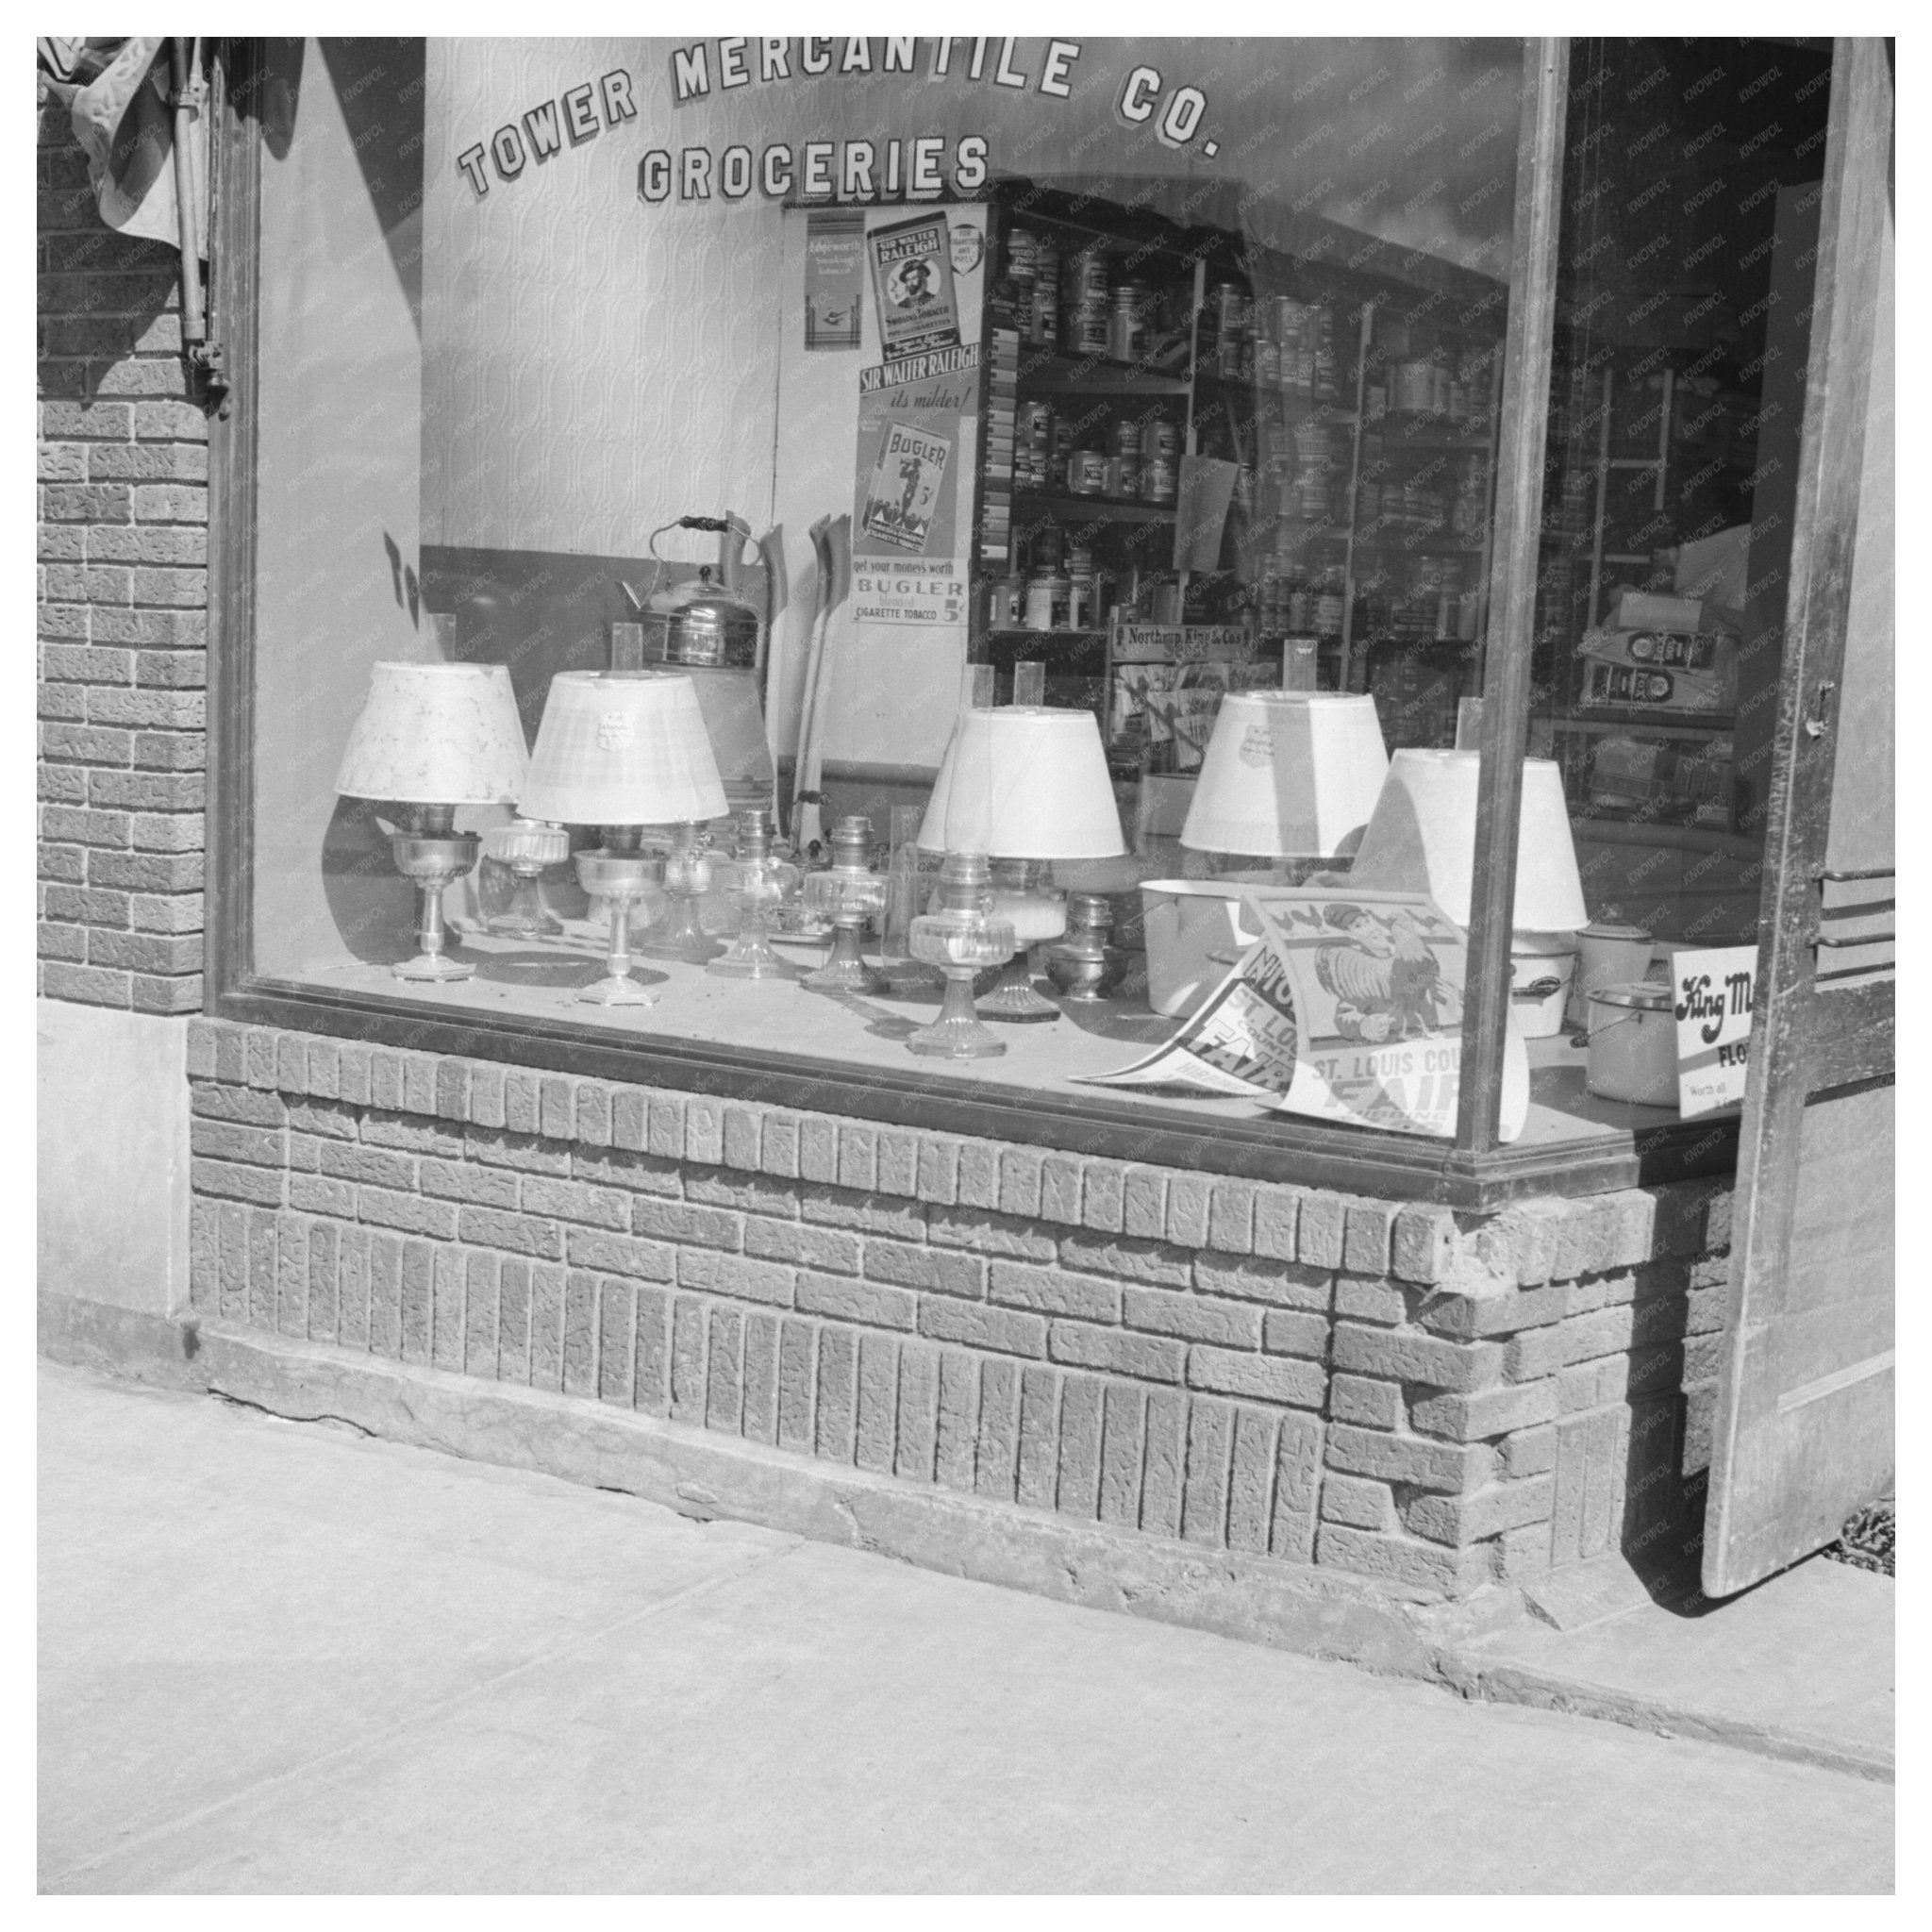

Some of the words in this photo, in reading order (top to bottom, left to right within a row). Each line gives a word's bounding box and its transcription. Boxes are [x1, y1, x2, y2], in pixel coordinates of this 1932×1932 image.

[457, 68, 638, 196] TOWER
[672, 37, 1081, 104] MERCANTILE
[1115, 64, 1220, 160] CO.
[640, 134, 991, 204] GROCERIES
[879, 240, 897, 251] SIR
[897, 229, 936, 244] WALTER
[880, 238, 939, 262] RALEIGH
[860, 368, 882, 392] SIR
[883, 357, 926, 388] WALTER
[927, 343, 978, 378] RALEIGH
[913, 384, 972, 412] milder!
[890, 434, 946, 471] BUGLER
[854, 559, 868, 573] get
[871, 561, 891, 573] your
[929, 561, 954, 575] worth
[858, 578, 963, 595] BUGLER
[856, 608, 900, 618] CIGARETTE
[904, 609, 937, 620] TOBACCO
[1227, 988, 1264, 1024] ST.
[1674, 974, 1725, 1044] King
[1725, 972, 1754, 1015] M
[1187, 1017, 1295, 1092] FAIR
[1238, 1019, 1297, 1061] COUNTY
[1718, 1042, 1750, 1068] FLO
[1312, 1058, 1343, 1080] ST.
[1353, 1052, 1414, 1078] LOUIS
